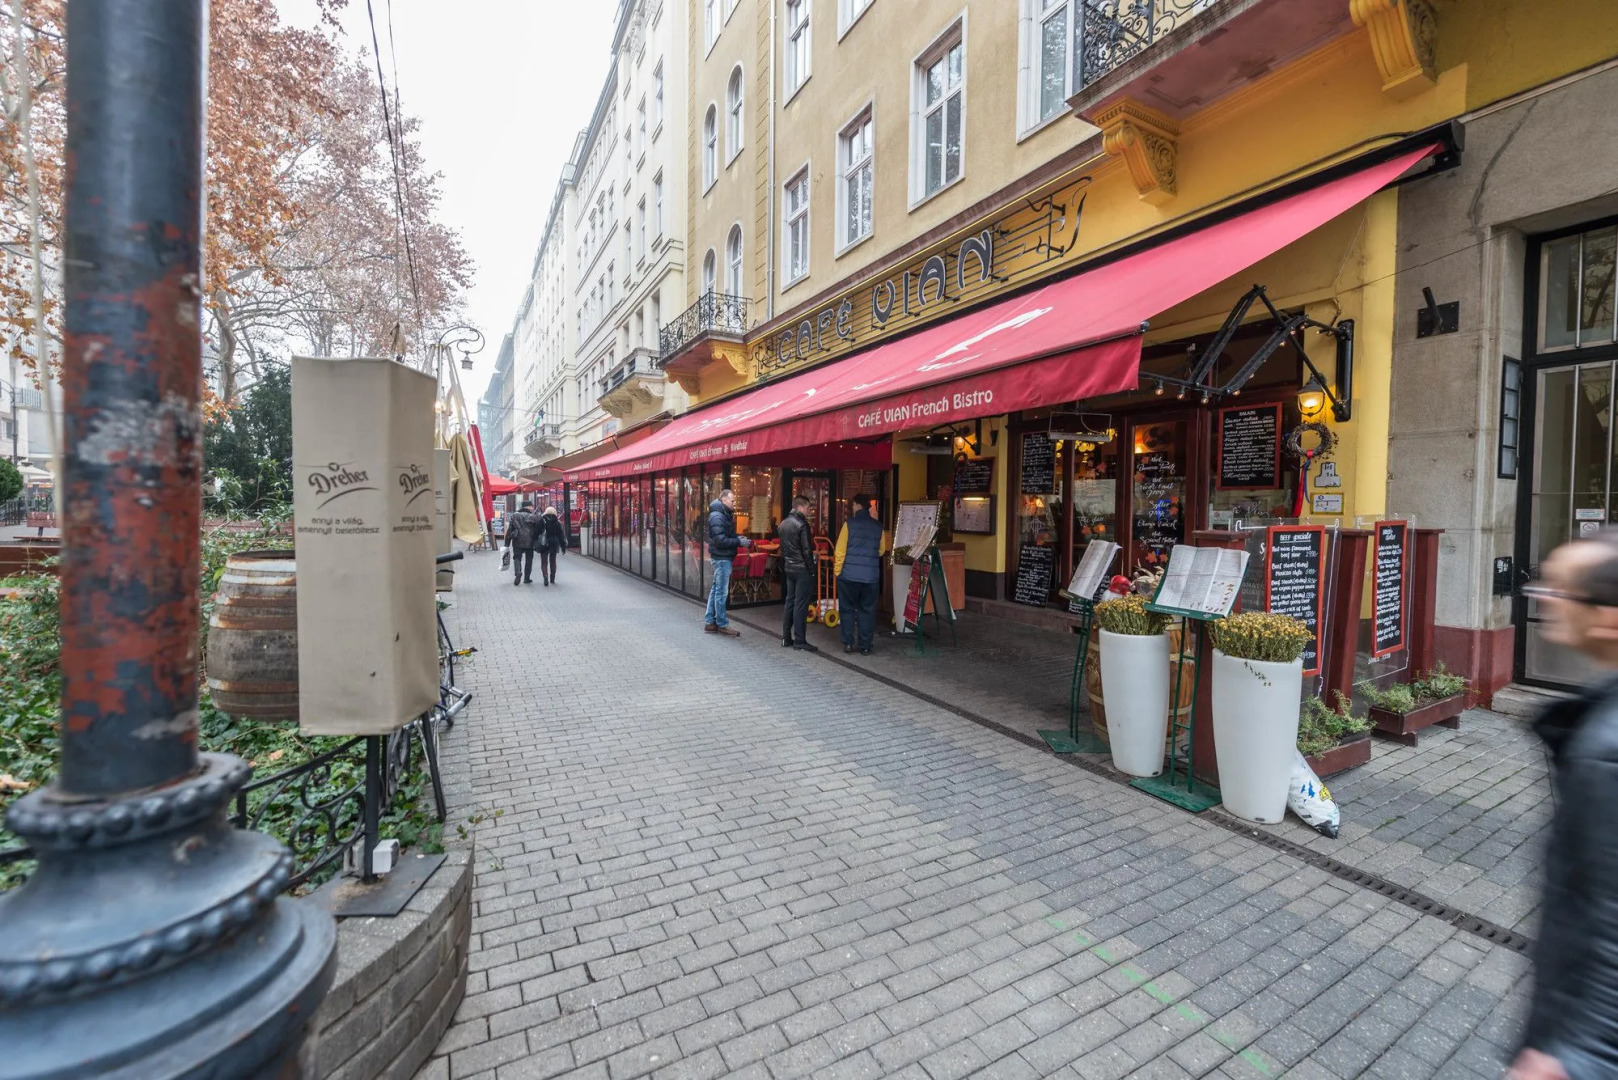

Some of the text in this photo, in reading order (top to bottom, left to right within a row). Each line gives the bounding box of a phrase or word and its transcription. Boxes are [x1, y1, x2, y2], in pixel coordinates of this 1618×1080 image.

[858, 390, 993, 428] CAFÉ VIAN French Bistro
[308, 467, 370, 495] Dreher
[399, 469, 429, 495] Dreher
